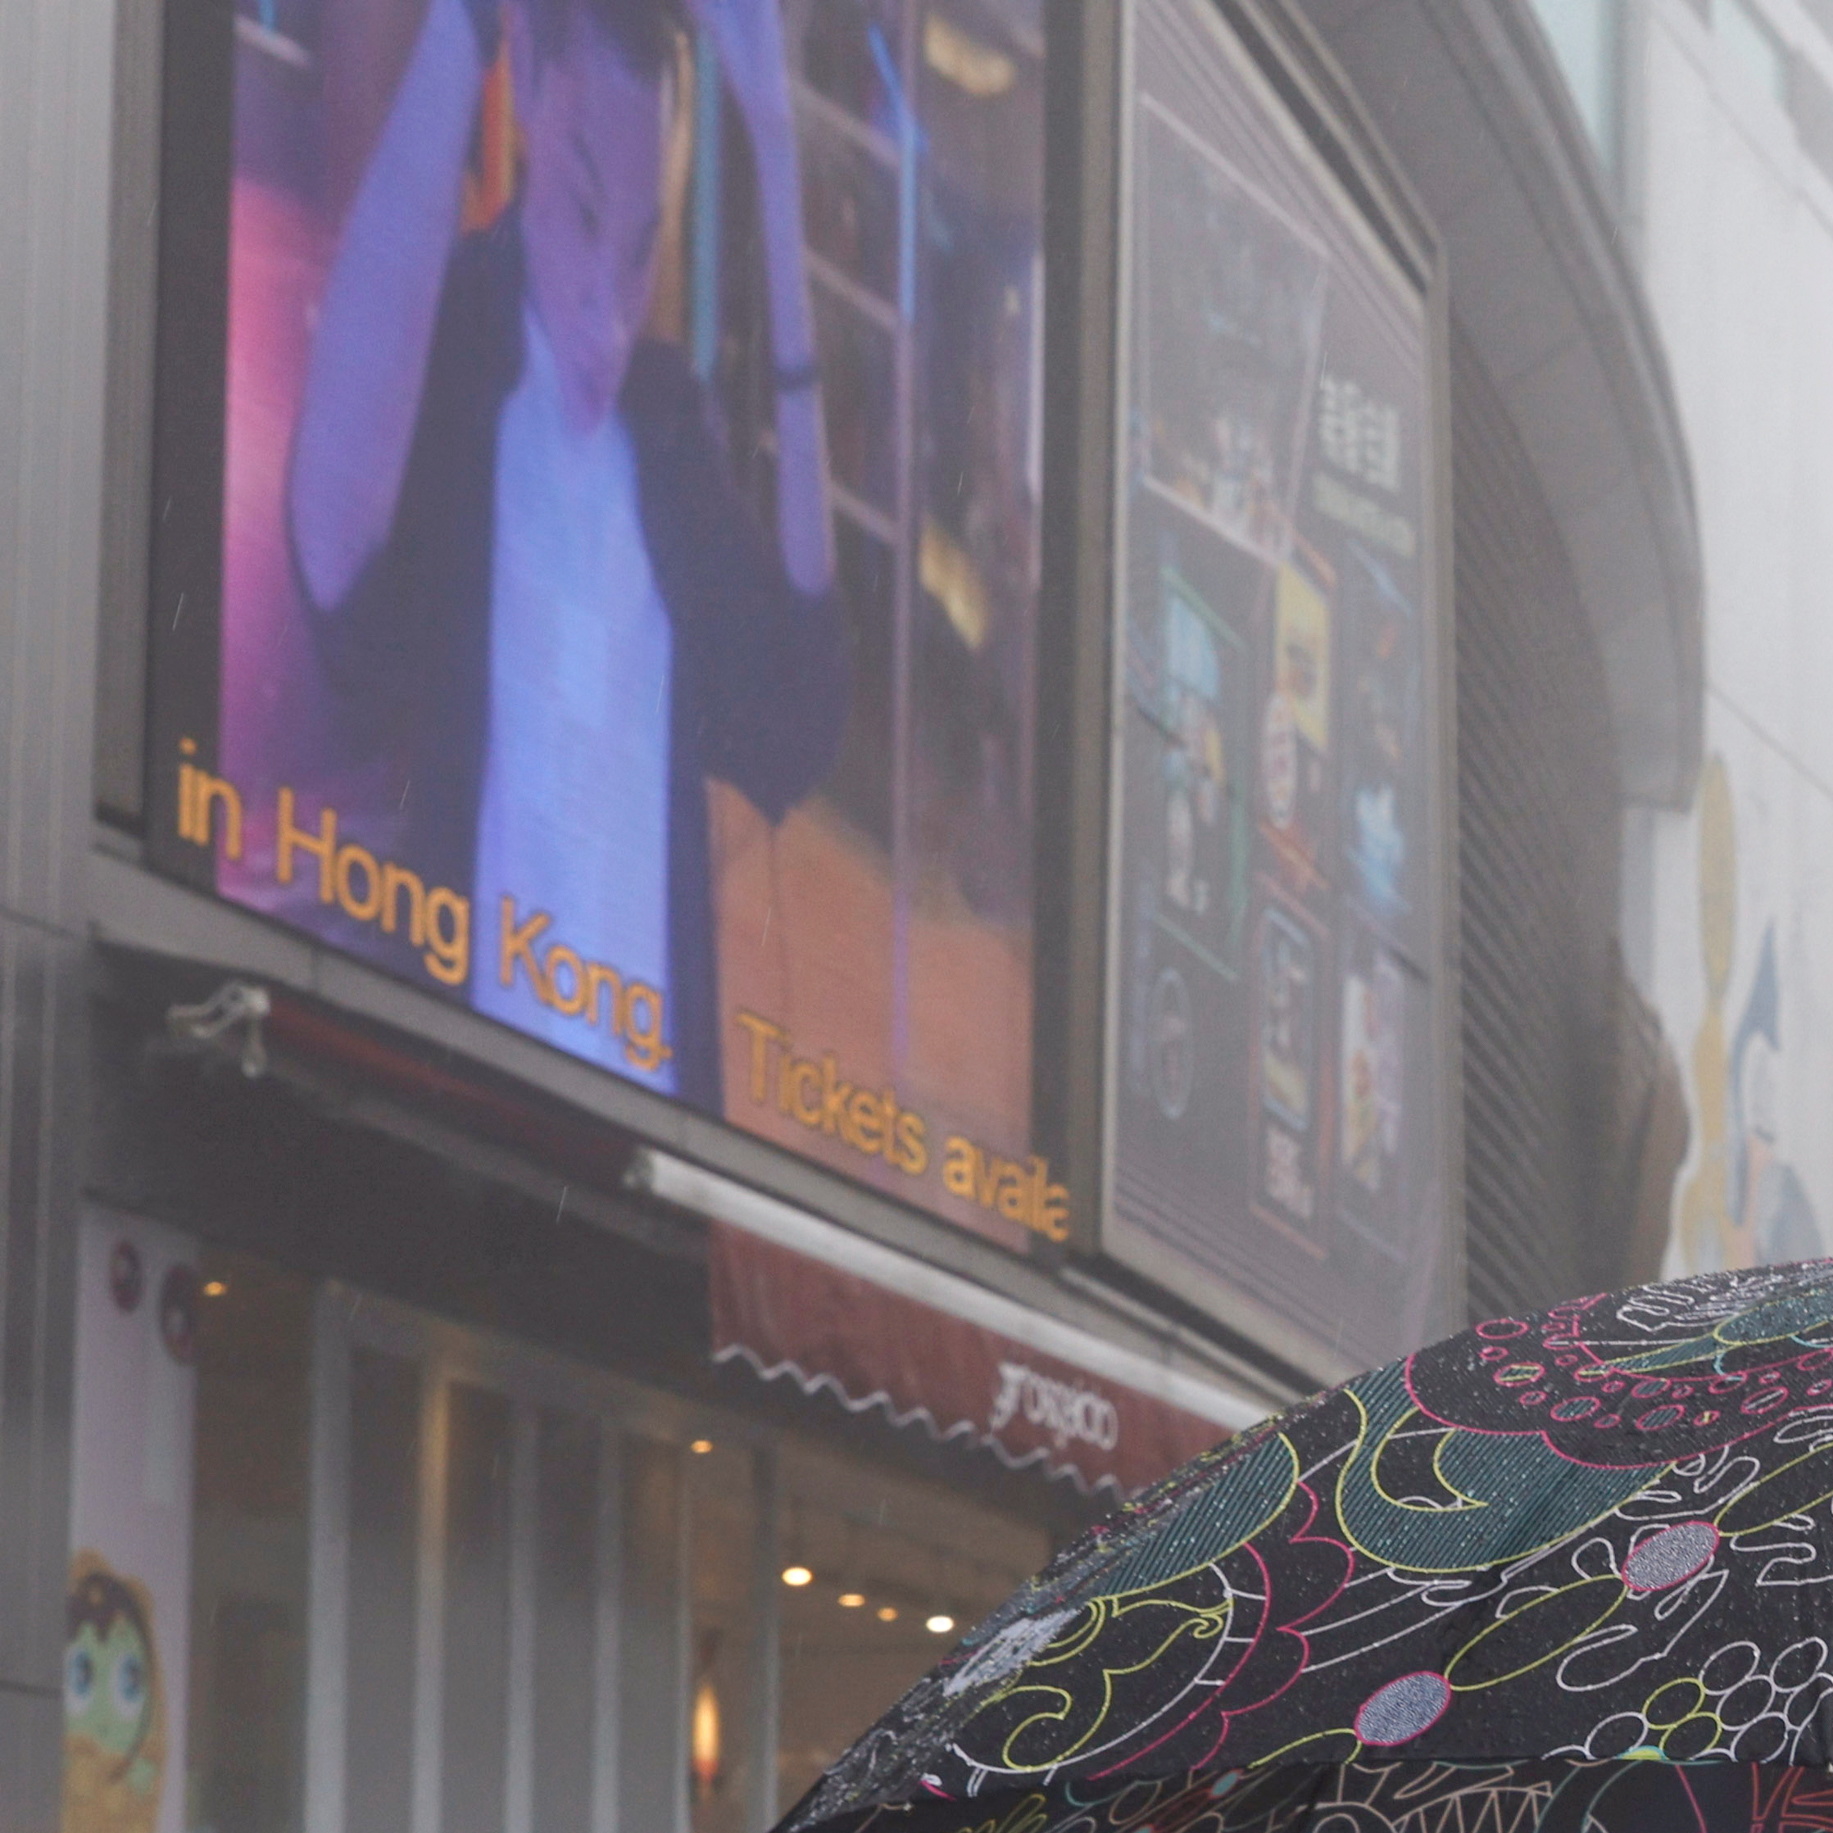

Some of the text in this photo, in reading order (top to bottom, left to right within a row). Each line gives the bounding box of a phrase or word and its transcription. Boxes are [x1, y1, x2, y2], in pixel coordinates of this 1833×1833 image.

[178, 737, 242, 861] in
[277, 786, 470, 985] Hong
[735, 1012, 928, 1175] Tickets
